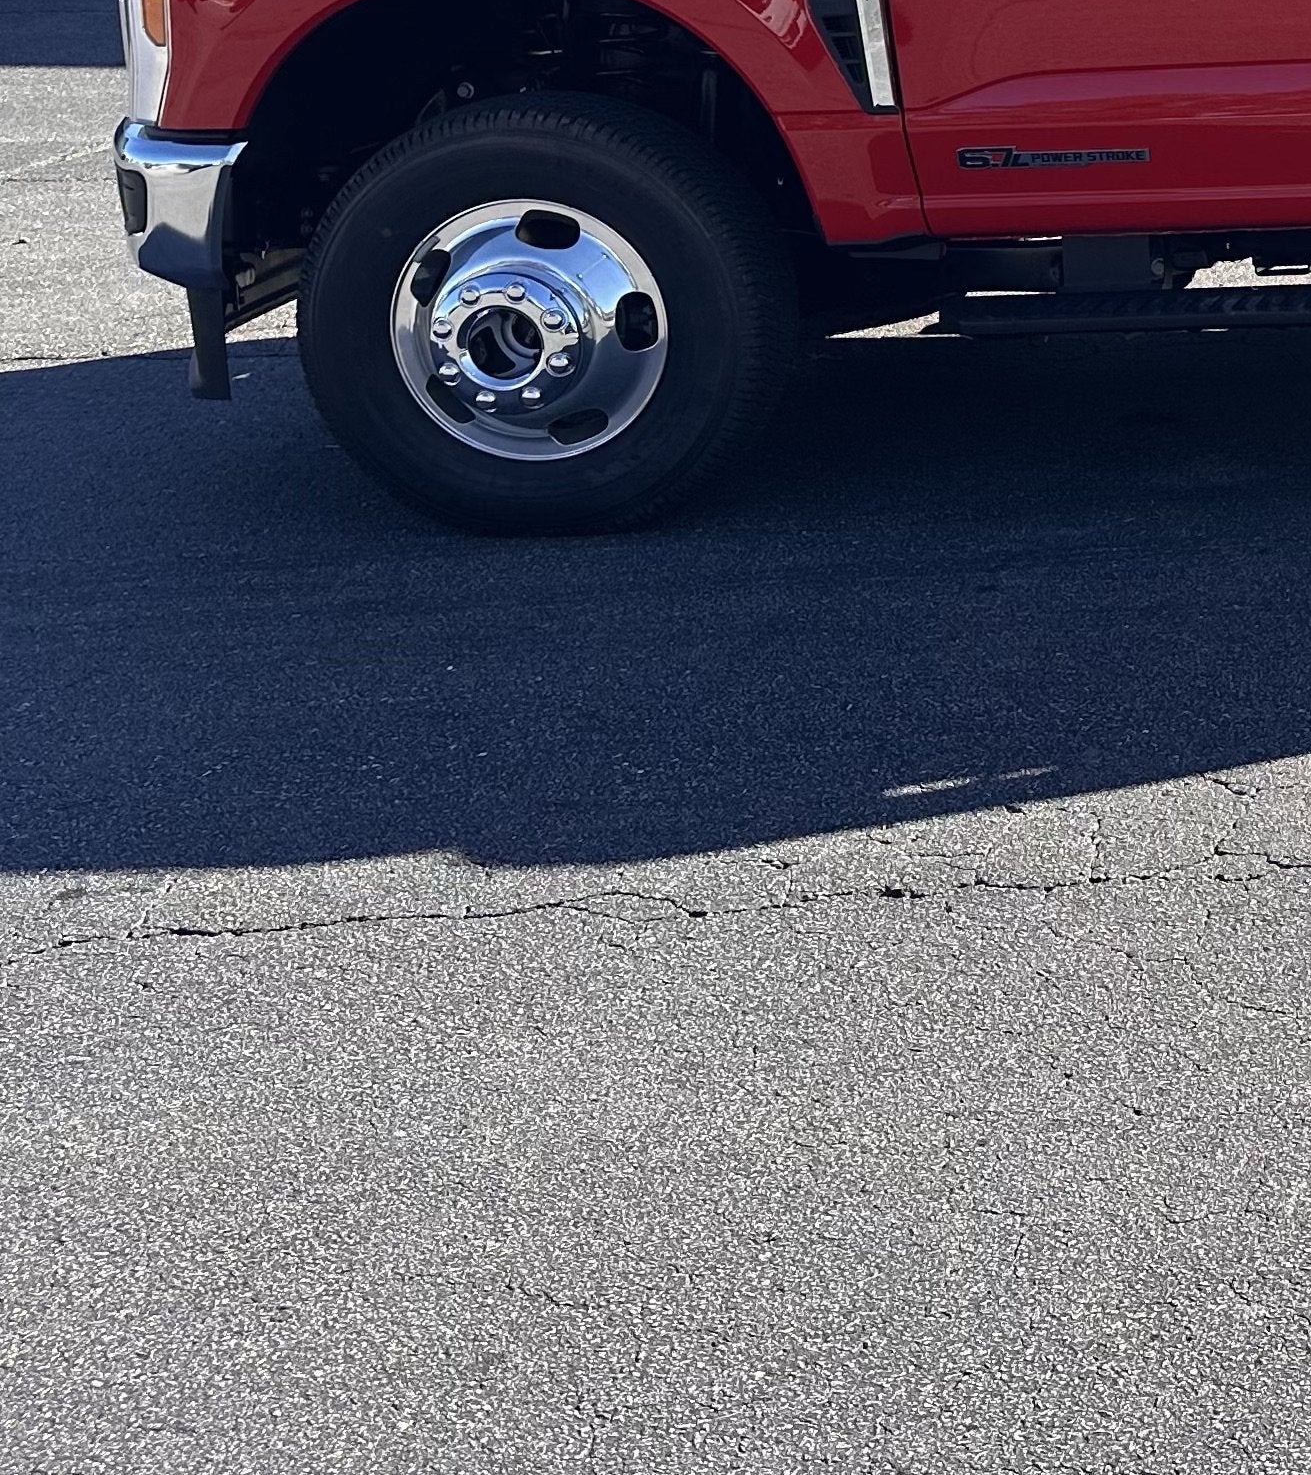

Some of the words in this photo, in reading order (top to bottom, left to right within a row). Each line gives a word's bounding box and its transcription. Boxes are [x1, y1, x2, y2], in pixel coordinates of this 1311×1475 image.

[956, 146, 1030, 169] 6.7L
[1031, 152, 1083, 163] POWER
[1087, 150, 1146, 162] STROKE
